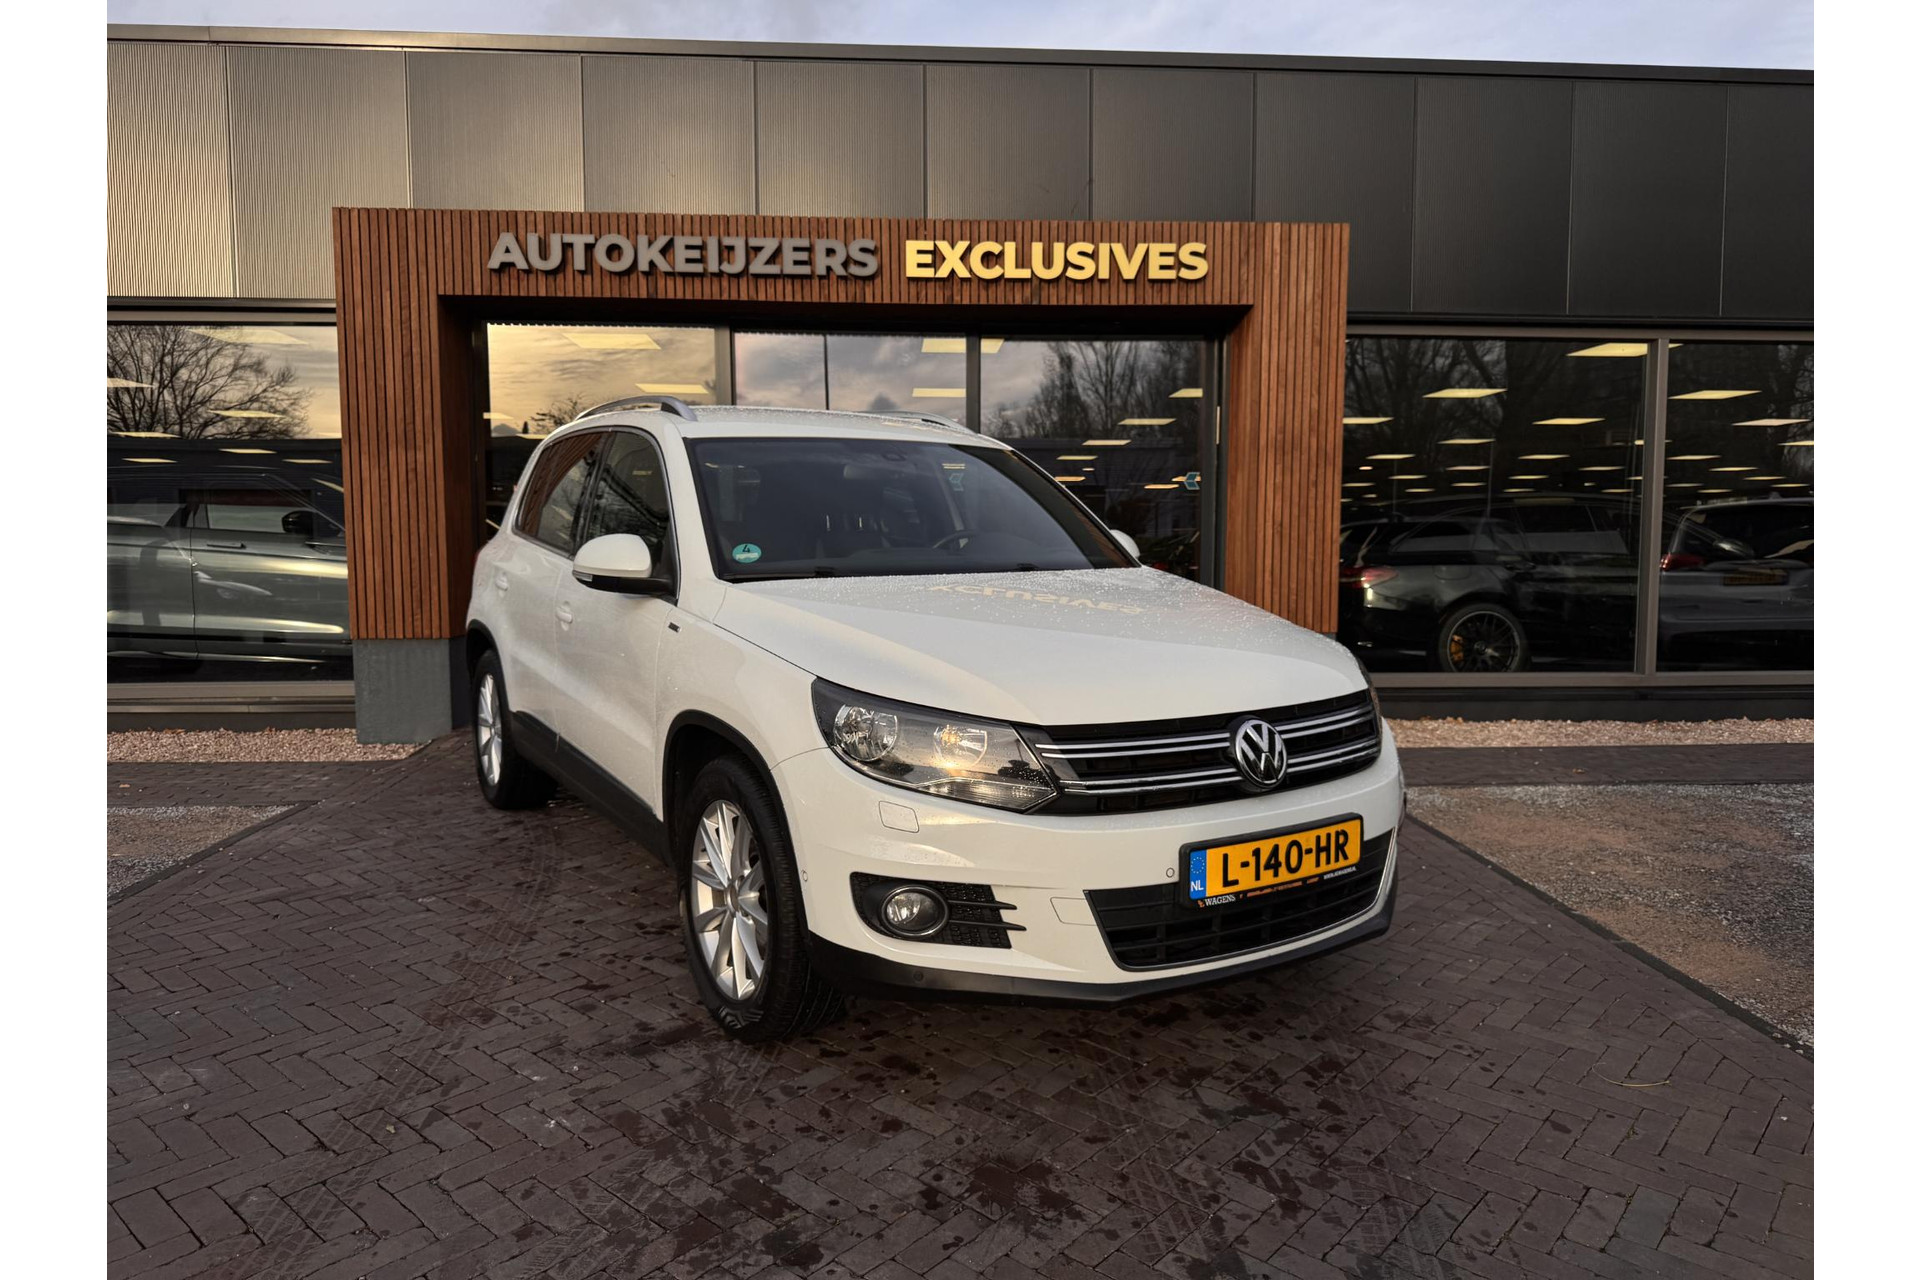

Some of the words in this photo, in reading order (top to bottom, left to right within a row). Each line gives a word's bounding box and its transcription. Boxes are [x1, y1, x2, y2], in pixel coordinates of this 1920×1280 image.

[487, 232, 879, 277] AUTOKEIJZERS
[905, 240, 1209, 280] EXCLUSIVES
[1222, 829, 1349, 888] L-140-HR
[1190, 880, 1204, 892] NL
[1204, 894, 1236, 907] WAGENS
